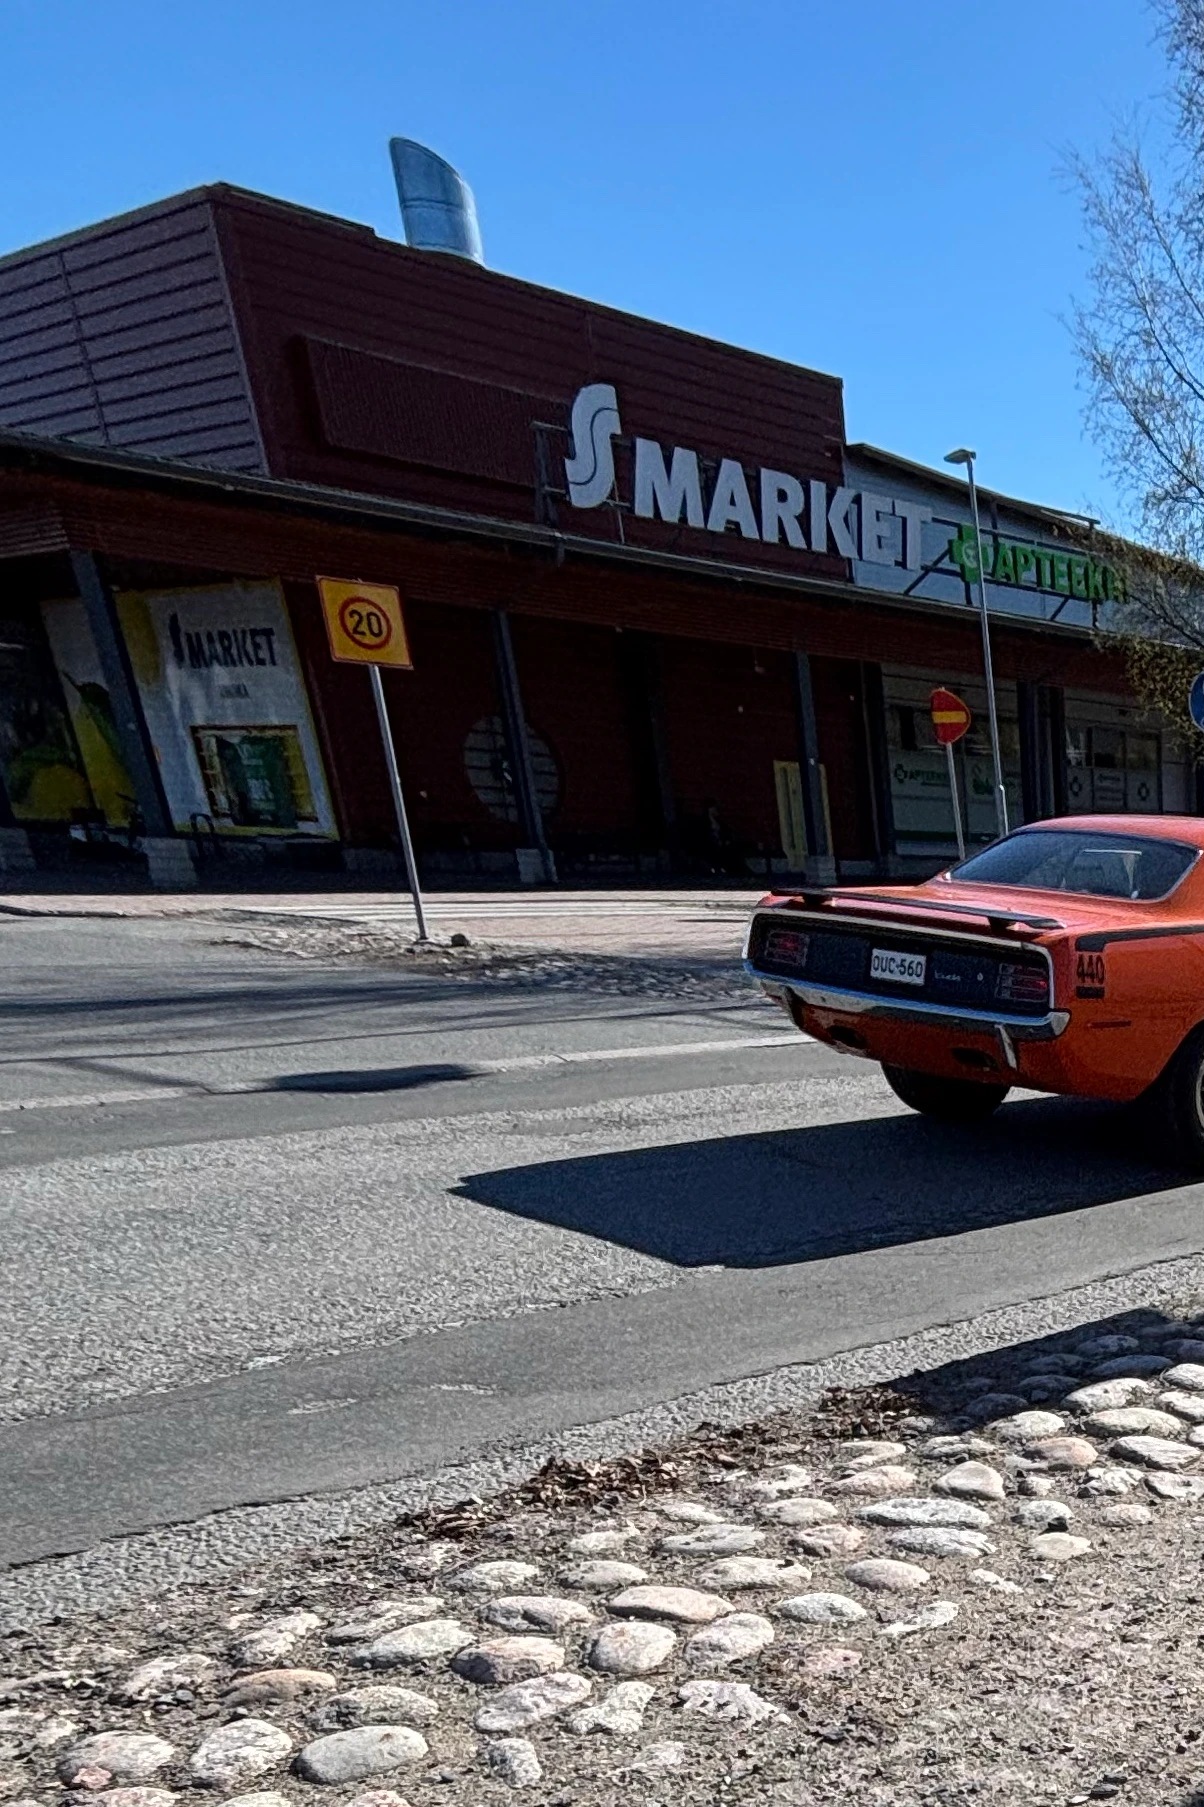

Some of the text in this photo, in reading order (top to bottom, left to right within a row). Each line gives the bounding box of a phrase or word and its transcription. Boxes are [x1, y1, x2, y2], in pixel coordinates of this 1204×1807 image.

[634, 437, 931, 571] MARKET
[348, 608, 383, 639] 20
[185, 627, 277, 669] MARKET
[873, 955, 923, 978] OUC-560
[1076, 953, 1105, 985] 440
